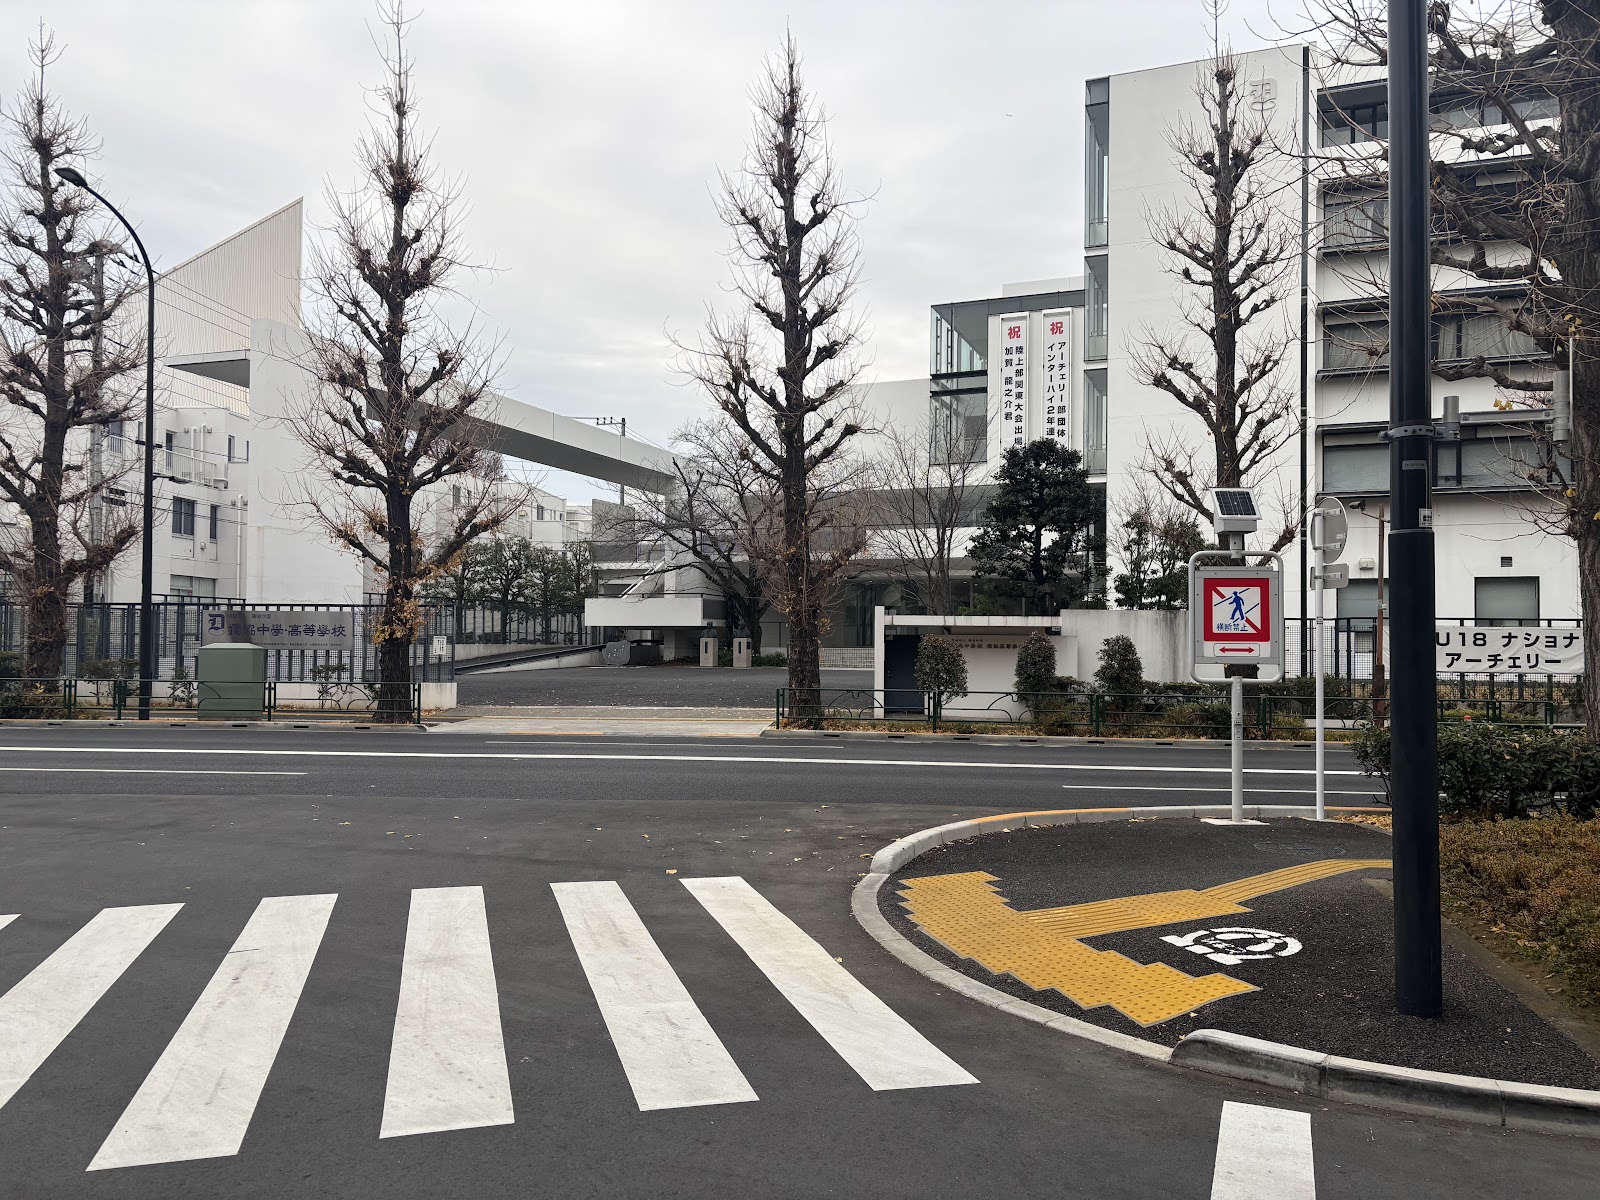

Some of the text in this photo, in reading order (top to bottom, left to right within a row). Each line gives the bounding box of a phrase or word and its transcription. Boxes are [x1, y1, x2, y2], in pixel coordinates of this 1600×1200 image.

[1007, 326, 1021, 339] 祝
[1050, 321, 1064, 335] 祝
[1014, 346, 1024, 446] 陸上部関東大会出場
[1057, 341, 1067, 438] アーチェリー部団体
[1216, 622, 1249, 632] 横断禁止
[1436, 632, 1487, 647] U18
[1445, 652, 1562, 669] アーチェリー
